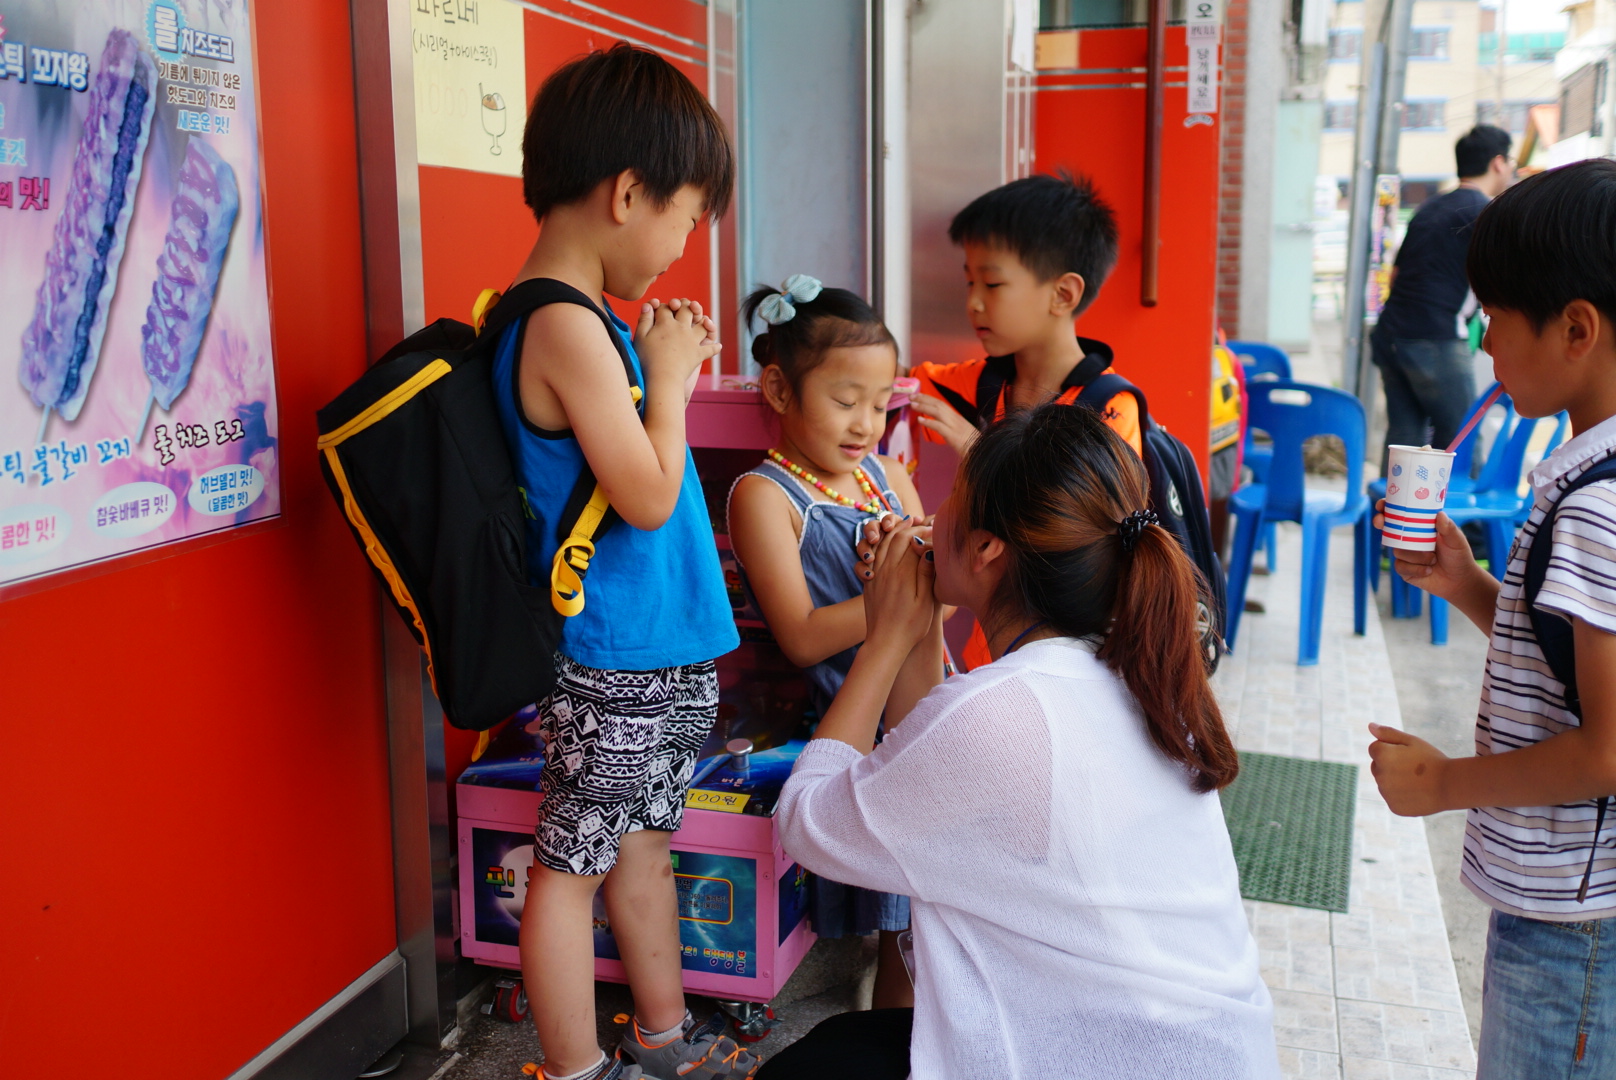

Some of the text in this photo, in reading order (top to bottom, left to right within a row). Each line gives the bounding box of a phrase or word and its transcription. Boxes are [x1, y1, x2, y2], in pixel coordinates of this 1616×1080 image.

[154, 5, 235, 62] 롤 치즈도그
[0, 43, 89, 91] 틱 꼬지왕
[160, 62, 241, 90] 기름에 튀기지 않은
[168, 86, 236, 110] 핫도그와 치즈의
[178, 110, 230, 134] 새로운 맛!
[19, 177, 50, 210] 맛!
[154, 419, 246, 466] 롤 치즈 도그
[0, 438, 130, 486] 틱 불갈비 꼬지
[201, 468, 253, 494] 허브델리 맛!
[97, 494, 168, 527] 참숯바베큐 맛!
[208, 491, 249, 513] (달콤한 맛)
[36, 516, 55, 542] 맛!
[689, 792, 738, 805] 100원
